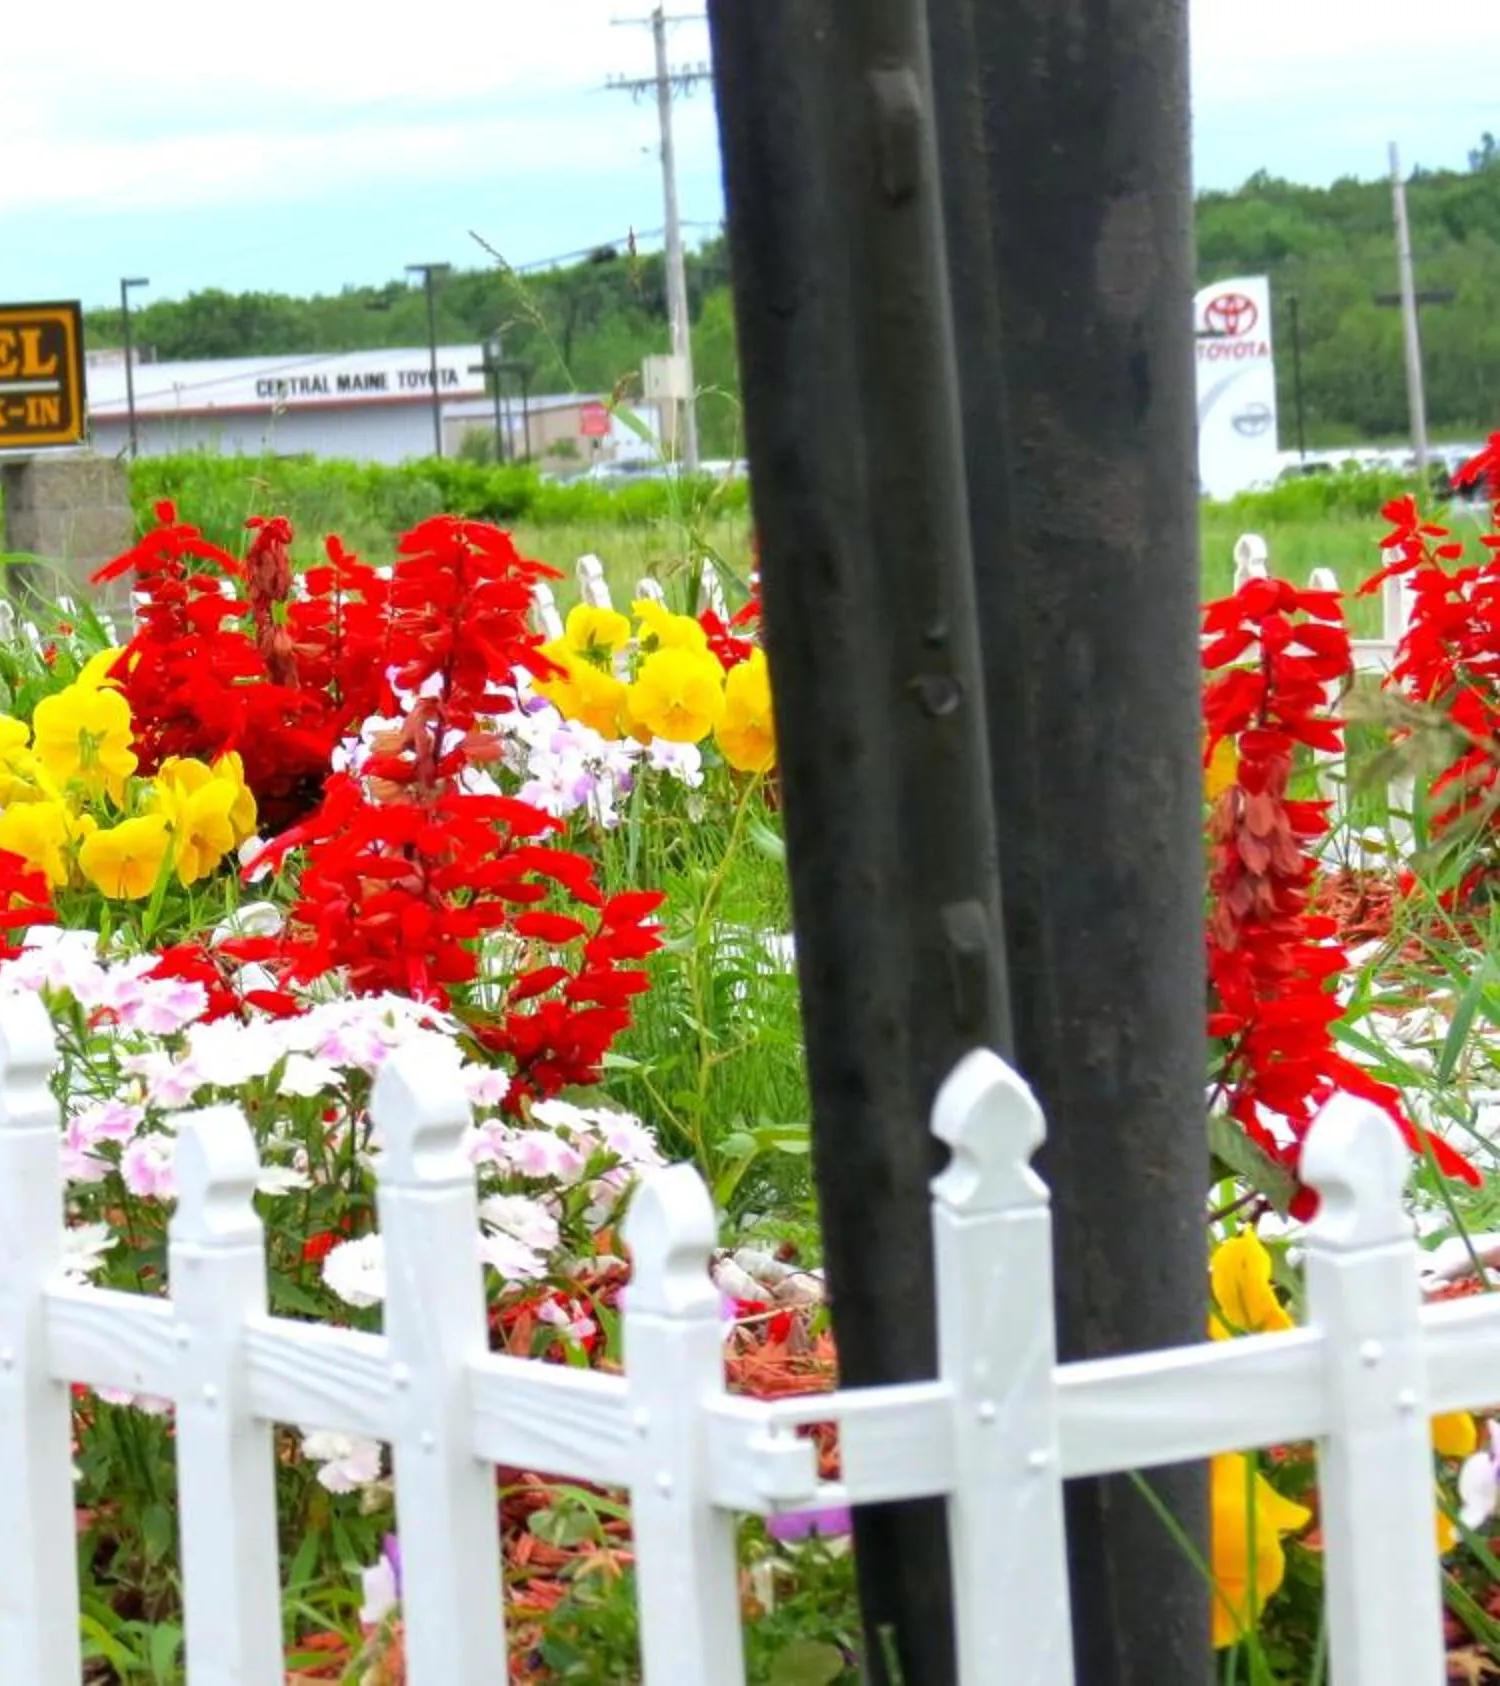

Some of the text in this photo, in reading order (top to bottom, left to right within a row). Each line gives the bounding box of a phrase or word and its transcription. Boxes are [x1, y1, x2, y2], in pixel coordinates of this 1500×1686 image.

[1196, 341, 1269, 361] TOYOTA
[336, 371, 388, 392] MAINE
[396, 366, 460, 389] TOYOTA
